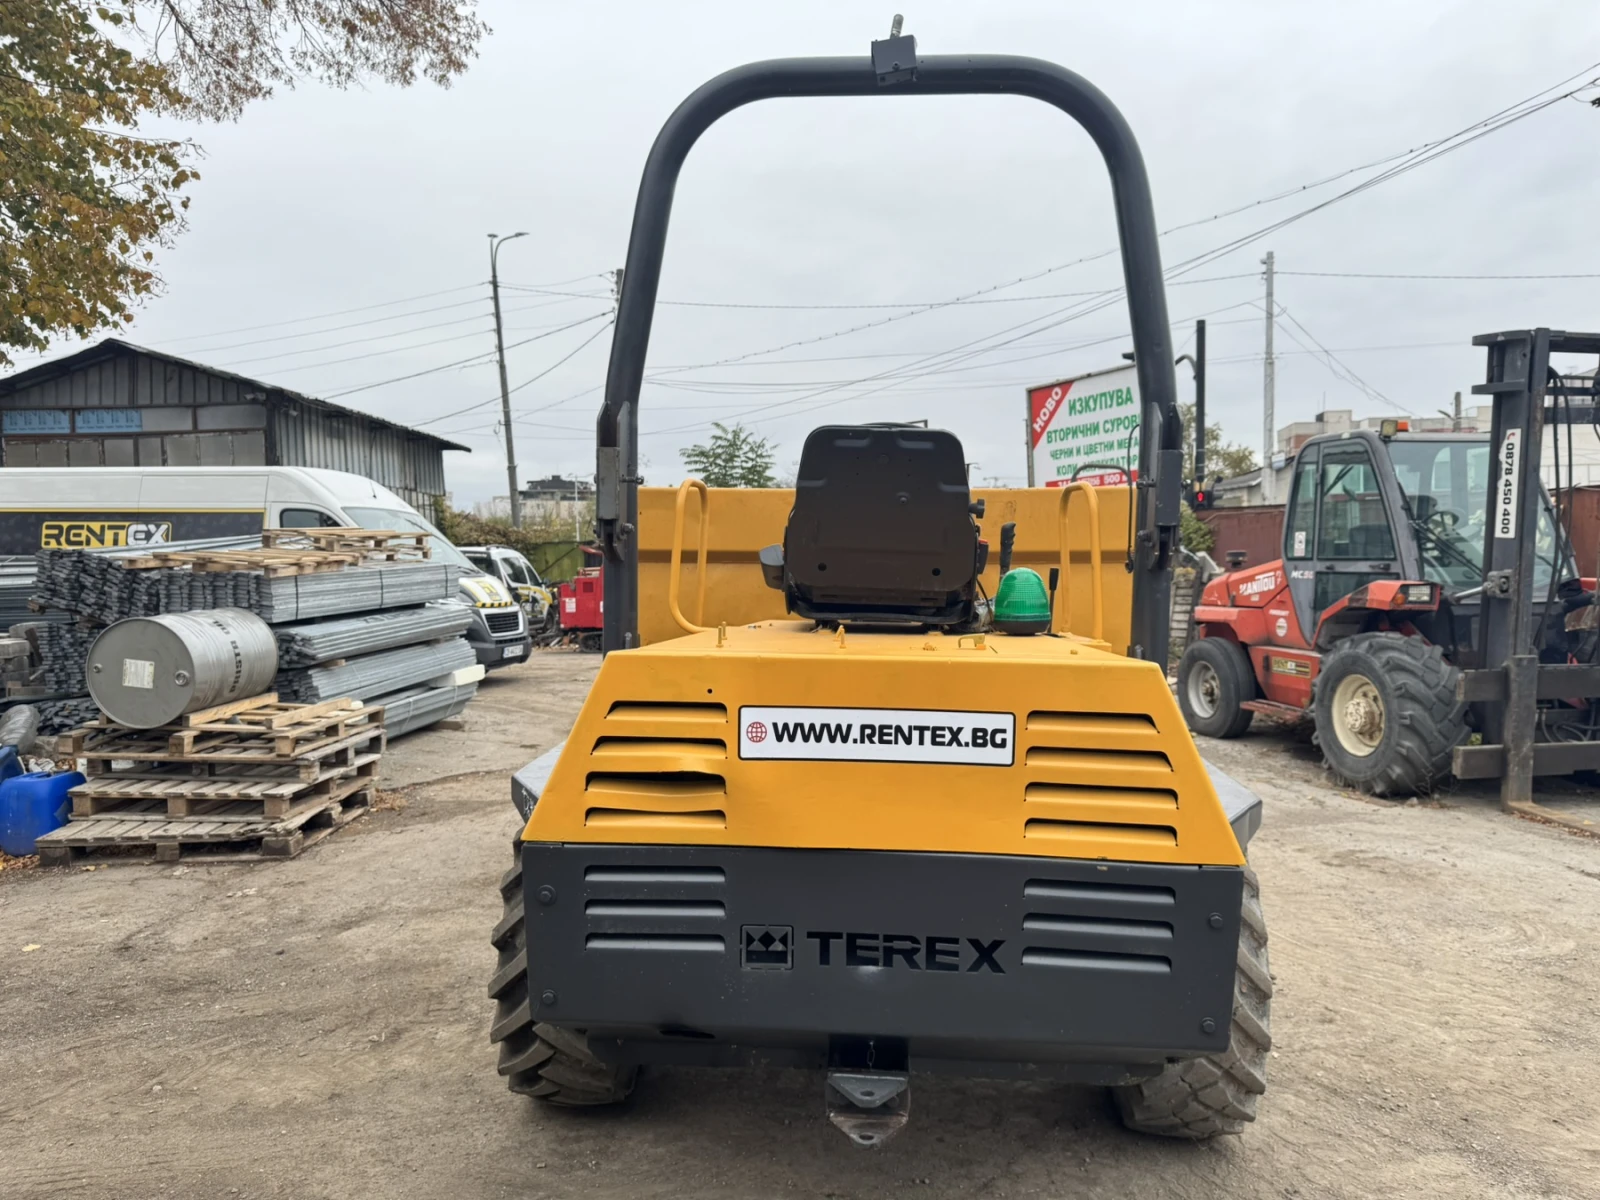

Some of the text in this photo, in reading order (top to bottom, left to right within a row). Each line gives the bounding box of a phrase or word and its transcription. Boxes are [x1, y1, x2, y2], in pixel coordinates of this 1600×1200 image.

[1032, 387, 1062, 433] НОВО
[1068, 386, 1133, 416] ИЗКУПУВА
[1047, 414, 1140, 444] ВТОРИЧНИ СУРОВ
[1050, 447, 1073, 460] ЧЕРНИ
[1076, 446, 1081, 456] И
[1083, 440, 1115, 457] ЦВЕТНИ
[1501, 442, 1515, 534] 0878 450 400
[44, 523, 169, 546] RENTEX
[1240, 572, 1275, 595] MANITOU
[772, 722, 1008, 749] WWW.RENTEX.BG
[806, 931, 1007, 974] TEREX
